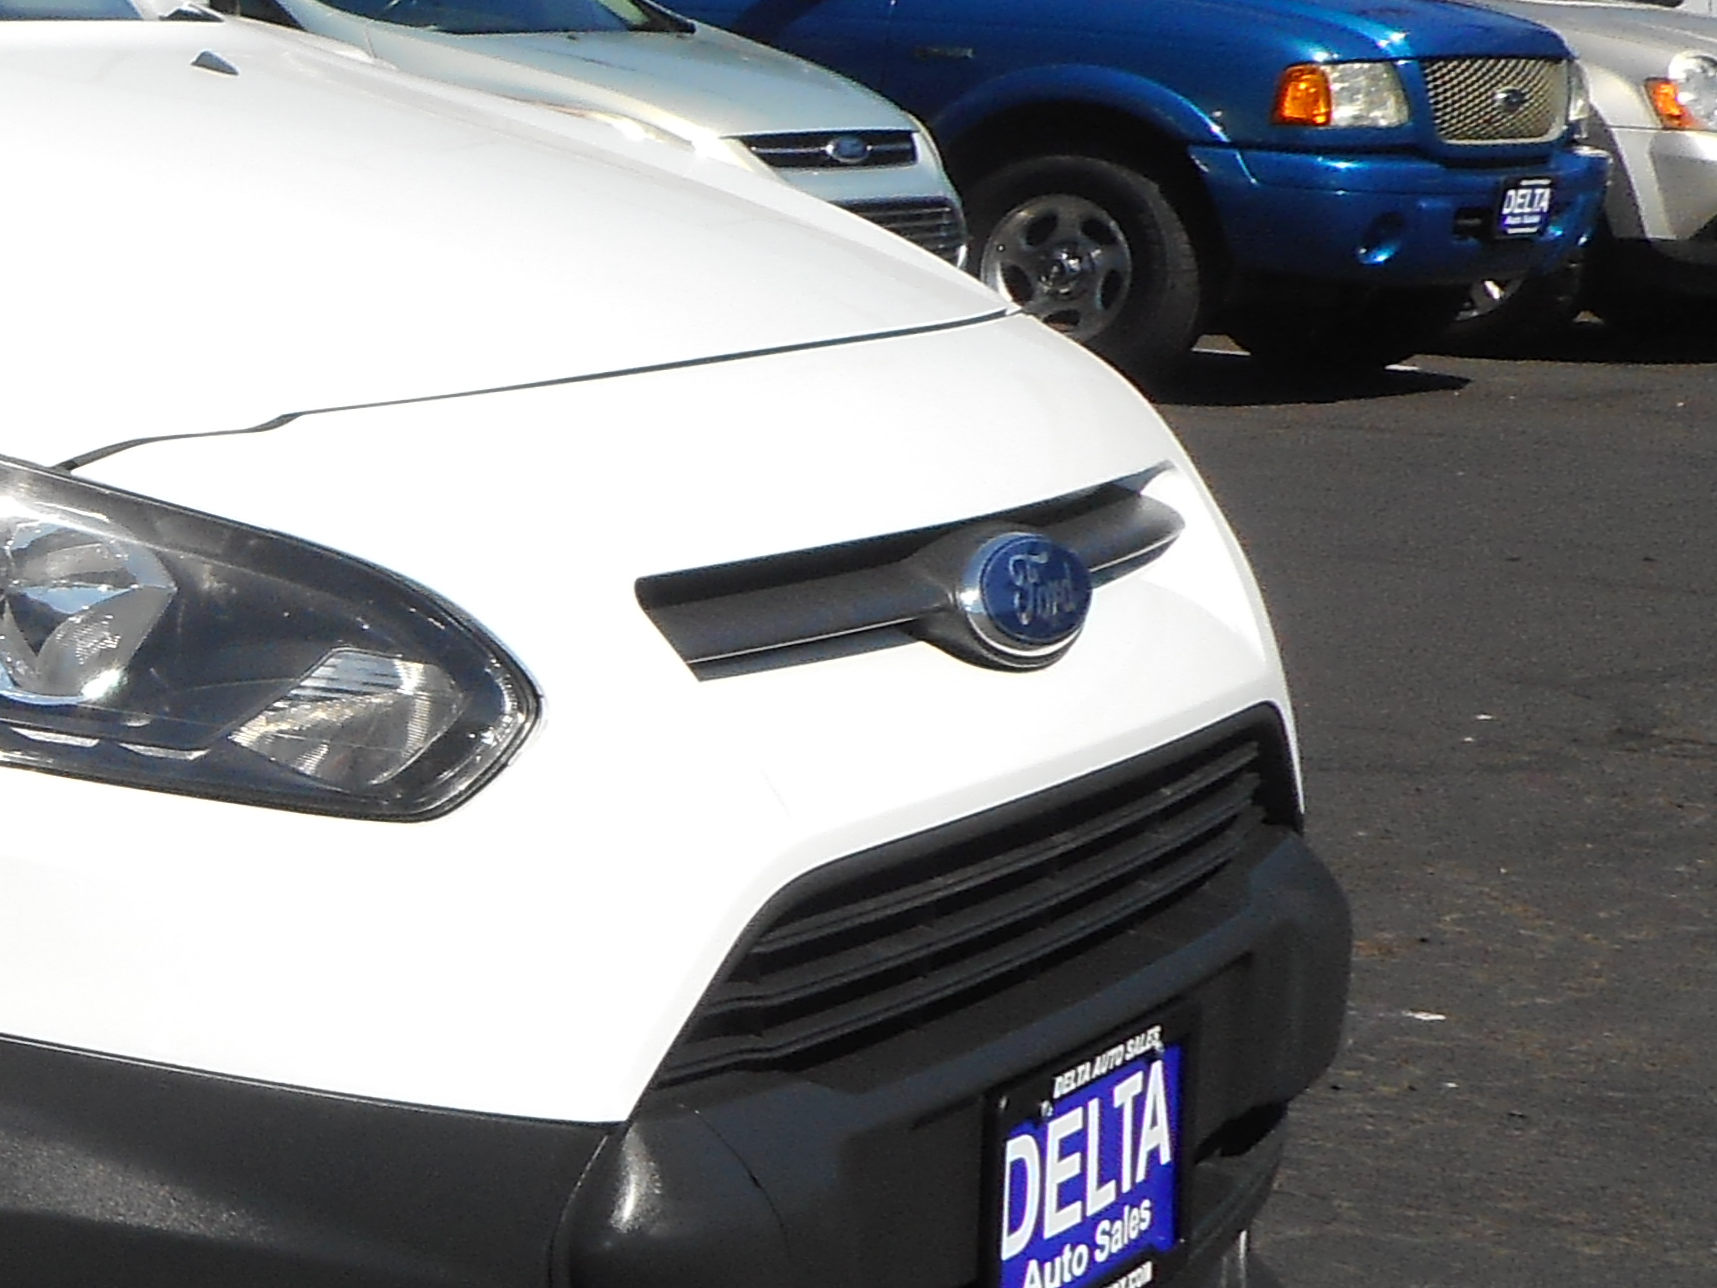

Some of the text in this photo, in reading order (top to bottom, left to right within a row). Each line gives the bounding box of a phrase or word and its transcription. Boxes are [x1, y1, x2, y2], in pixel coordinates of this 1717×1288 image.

[1502, 187, 1551, 215] DELTA
[1008, 552, 1077, 625] Ford
[1053, 1025, 1162, 1099] DELTA AUTO SALES
[1001, 1059, 1172, 1261] DELTA
[1094, 1199, 1152, 1263] Sales
